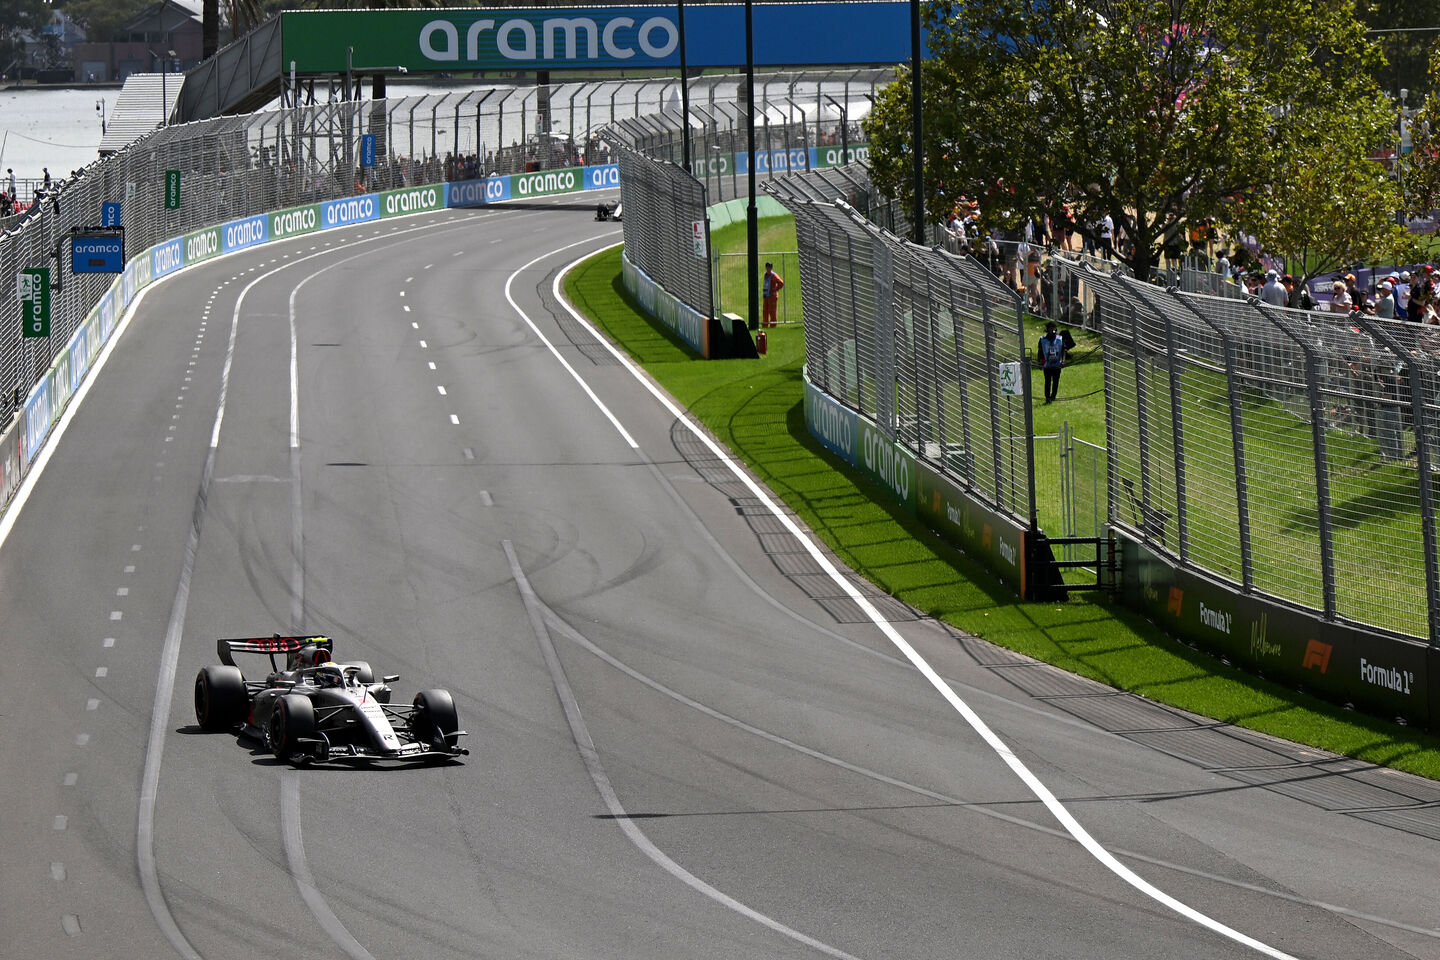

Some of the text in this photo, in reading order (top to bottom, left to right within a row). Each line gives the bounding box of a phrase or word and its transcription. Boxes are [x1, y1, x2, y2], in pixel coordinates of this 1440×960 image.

[419, 16, 679, 61] aramco
[365, 136, 373, 166] aramco
[451, 179, 503, 203] aramco
[519, 171, 575, 194] aramco
[327, 197, 373, 224] aramco
[386, 188, 437, 214] aramco
[227, 219, 263, 248] aramco
[273, 208, 316, 235] aramco
[75, 244, 120, 253] aramco
[154, 242, 180, 274] aramco
[187, 230, 218, 261] aramco
[33, 273, 42, 332] aramco
[813, 394, 851, 455] aramco
[864, 427, 909, 501] aramco
[1200, 601, 1226, 632] Formula
[1360, 657, 1403, 693] Formula
